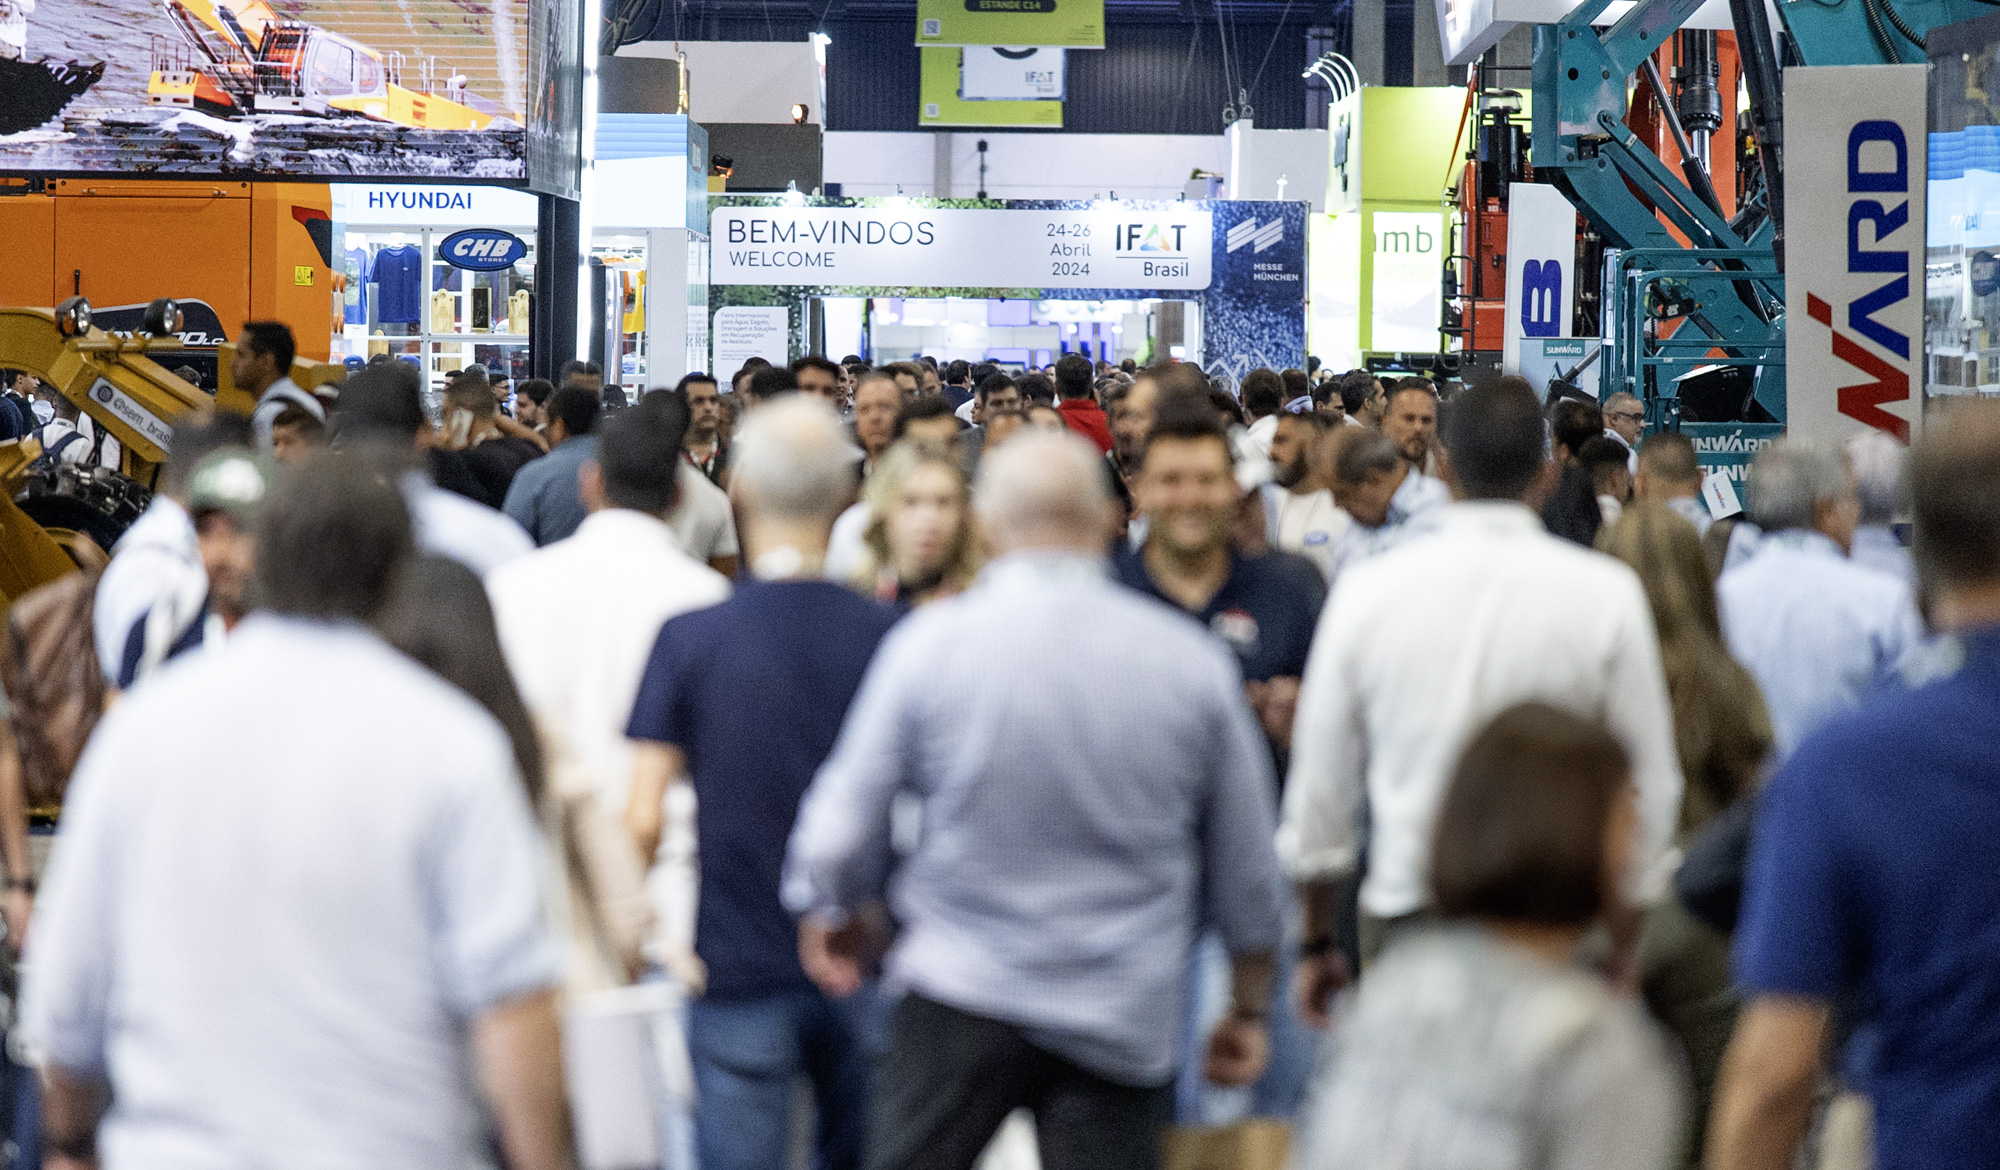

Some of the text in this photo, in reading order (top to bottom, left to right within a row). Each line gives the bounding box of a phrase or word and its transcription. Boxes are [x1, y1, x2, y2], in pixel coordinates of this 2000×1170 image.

[979, 0, 1041, 10] ESTANDE C14
[1025, 71, 1054, 83] IFAT
[369, 191, 472, 209] HYUNDAI
[728, 219, 934, 245] BEM-VINDOS
[1046, 223, 1091, 237] 24-26
[1115, 223, 1188, 252] IFAT
[453, 238, 513, 257] CHB
[1050, 243, 1091, 257] Abril
[729, 251, 836, 267] WELCOME
[1051, 262, 1091, 276] 2024
[1143, 261, 1189, 277] Brasil
[1253, 263, 1283, 271] MESSE
[1253, 271, 1299, 282] MÜNCHEN
[1546, 343, 1583, 354] SUNWARD
